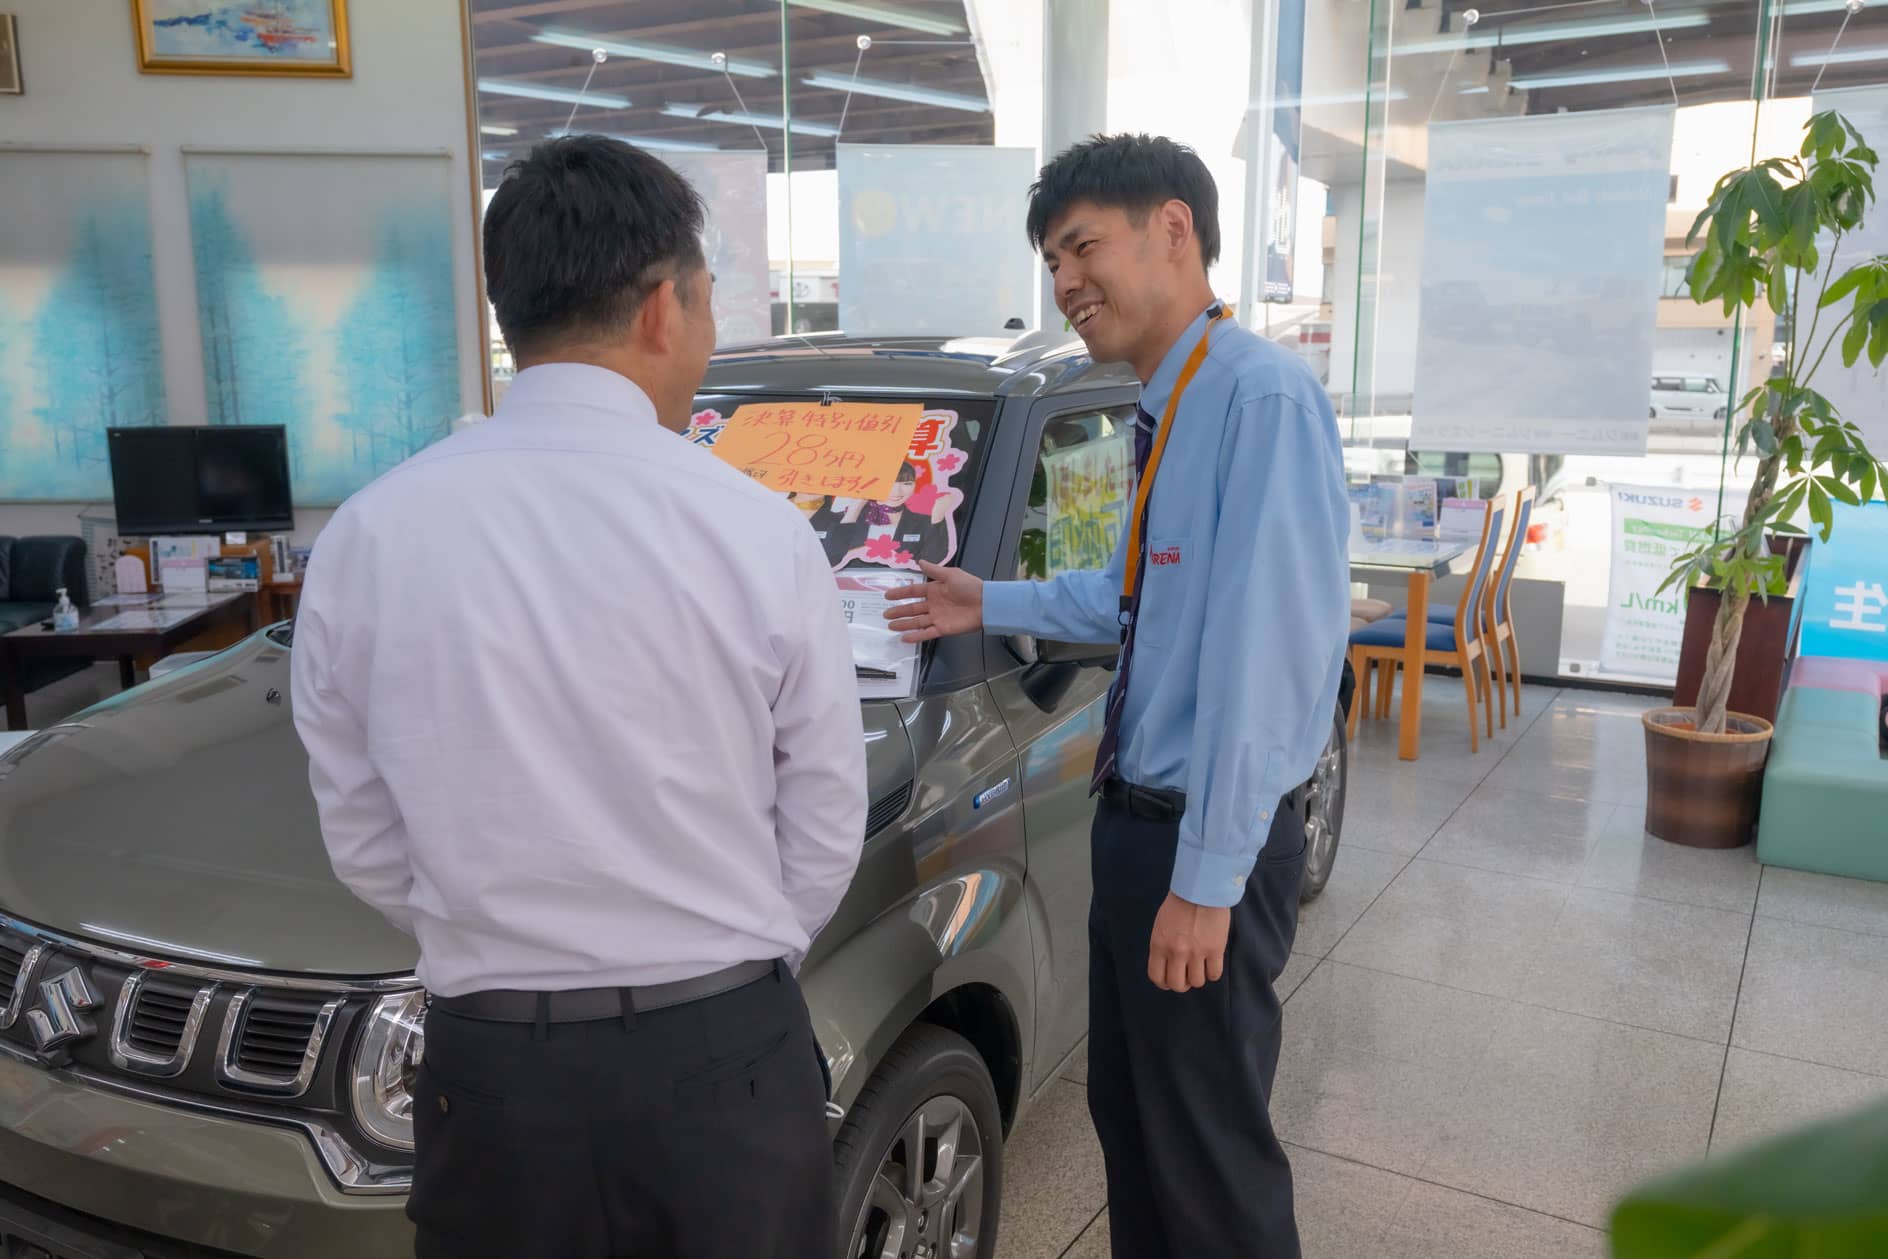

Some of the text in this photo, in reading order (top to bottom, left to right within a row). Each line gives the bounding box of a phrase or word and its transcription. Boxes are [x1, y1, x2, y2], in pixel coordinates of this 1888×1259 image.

[743, 408, 903, 434] 決算特別値引
